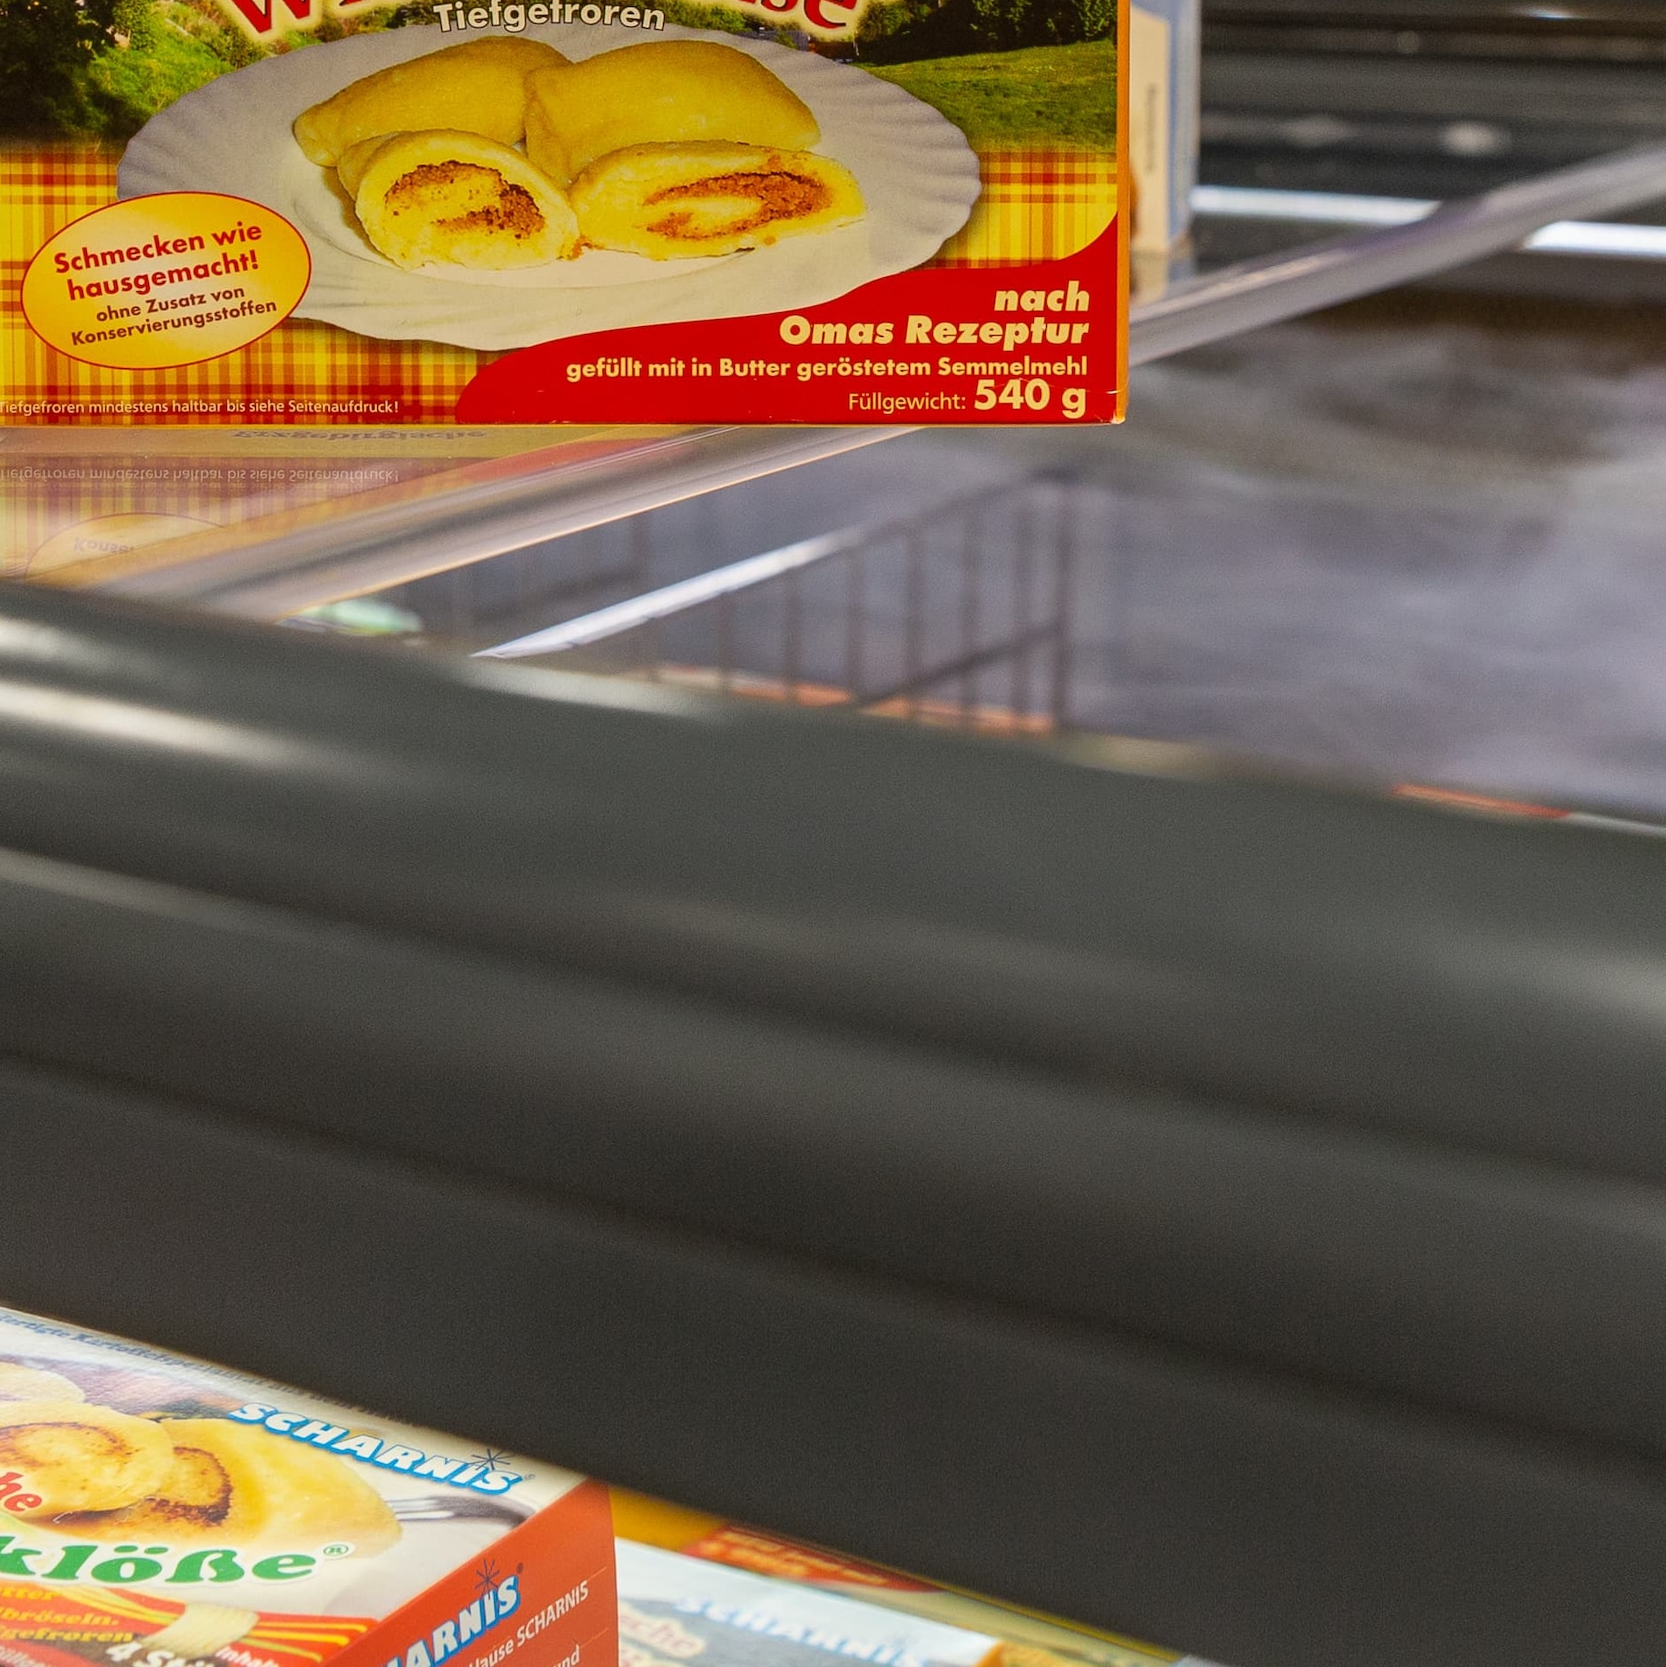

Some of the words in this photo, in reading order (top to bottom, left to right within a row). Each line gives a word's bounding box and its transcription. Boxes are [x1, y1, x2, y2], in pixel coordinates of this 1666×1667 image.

[53, 235, 205, 273] Schmecken
[211, 221, 263, 245] wie
[67, 250, 259, 300] hausgemacht!
[96, 302, 141, 322] ohne
[146, 294, 207, 314] Zusatz
[210, 286, 245, 302] von
[994, 280, 1090, 312] nach
[71, 300, 277, 346] Konservierungsstoffen
[779, 315, 894, 346] Omas
[905, 316, 1089, 350] Rezeptur
[566, 357, 642, 382] gefüllt
[648, 357, 685, 376] mit
[691, 357, 711, 376] in
[719, 357, 790, 376] Butter
[797, 357, 931, 382] geröstetem
[938, 356, 1088, 376] Semmelmehl
[89, 400, 169, 413] mindestens
[172, 399, 223, 413] haltbar
[226, 399, 245, 413] bis
[249, 399, 285, 413] siehe
[289, 399, 399, 414] Seitenaufdruck!
[848, 392, 966, 413] Füllgewicht:
[973, 379, 1051, 411] 540
[1062, 386, 1087, 418] g
[228, 1402, 523, 1495] SCHARNIS
[517, 1580, 590, 1648] SCHARNIS
